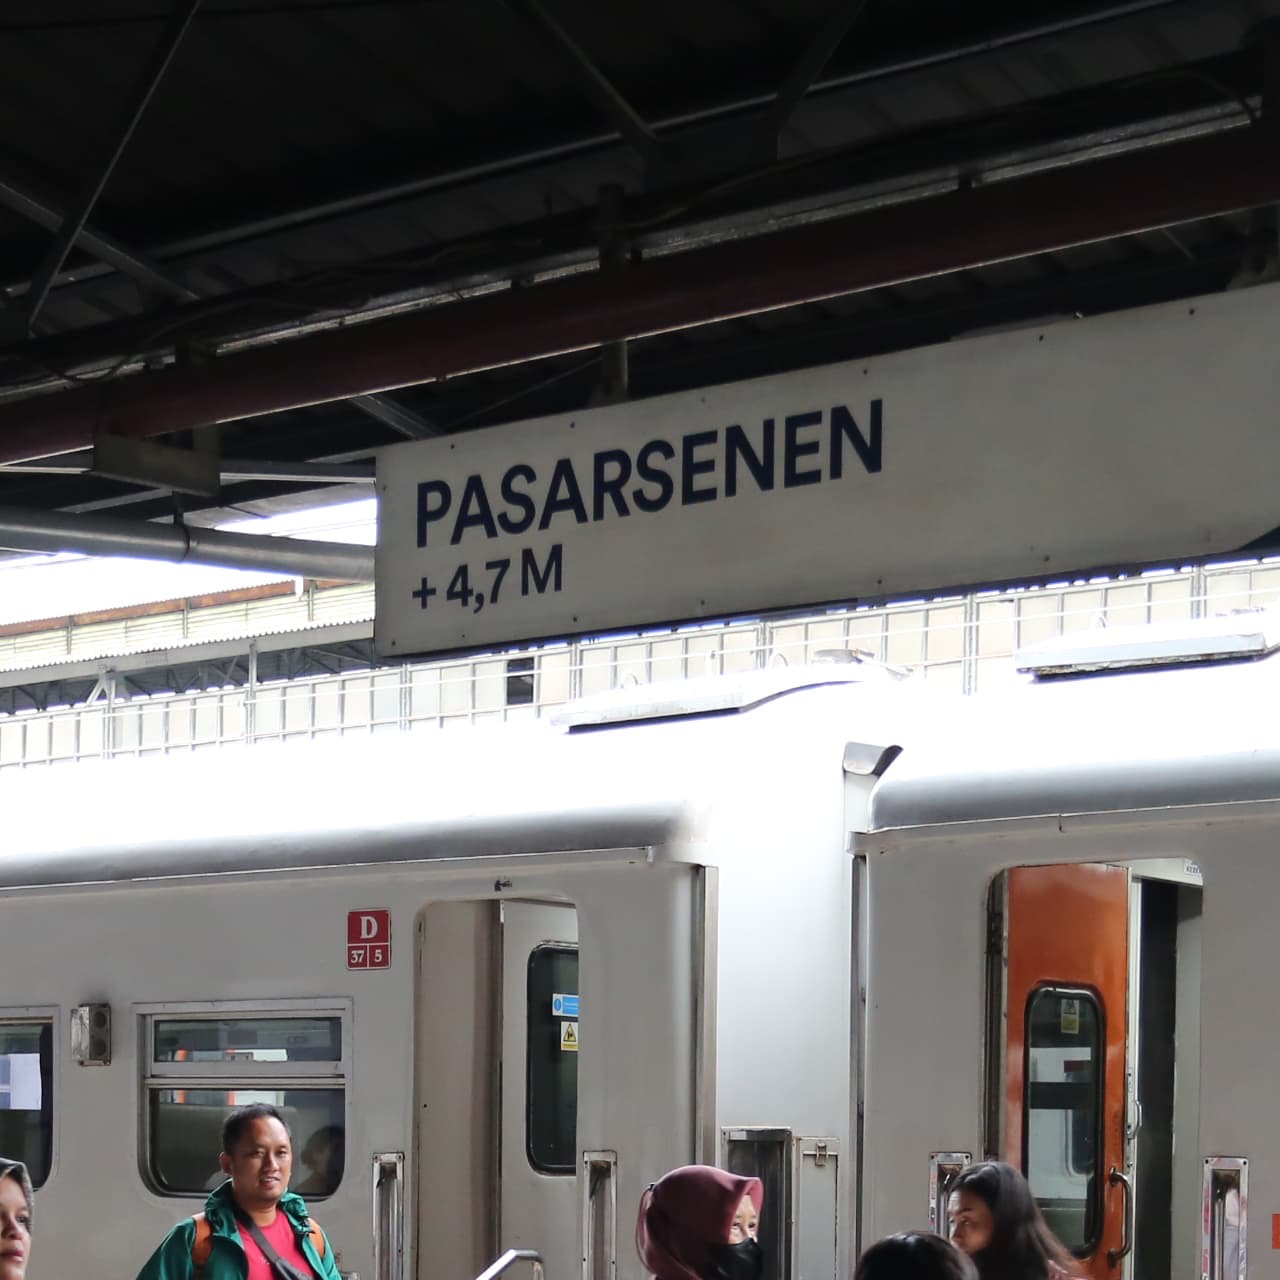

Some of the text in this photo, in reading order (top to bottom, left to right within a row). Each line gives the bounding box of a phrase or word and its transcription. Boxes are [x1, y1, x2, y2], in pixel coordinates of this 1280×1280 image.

[417, 398, 883, 548] PASARSENEN
[360, 915, 379, 939] D
[350, 949, 365, 963] 37
[374, 949, 383, 963] 5
